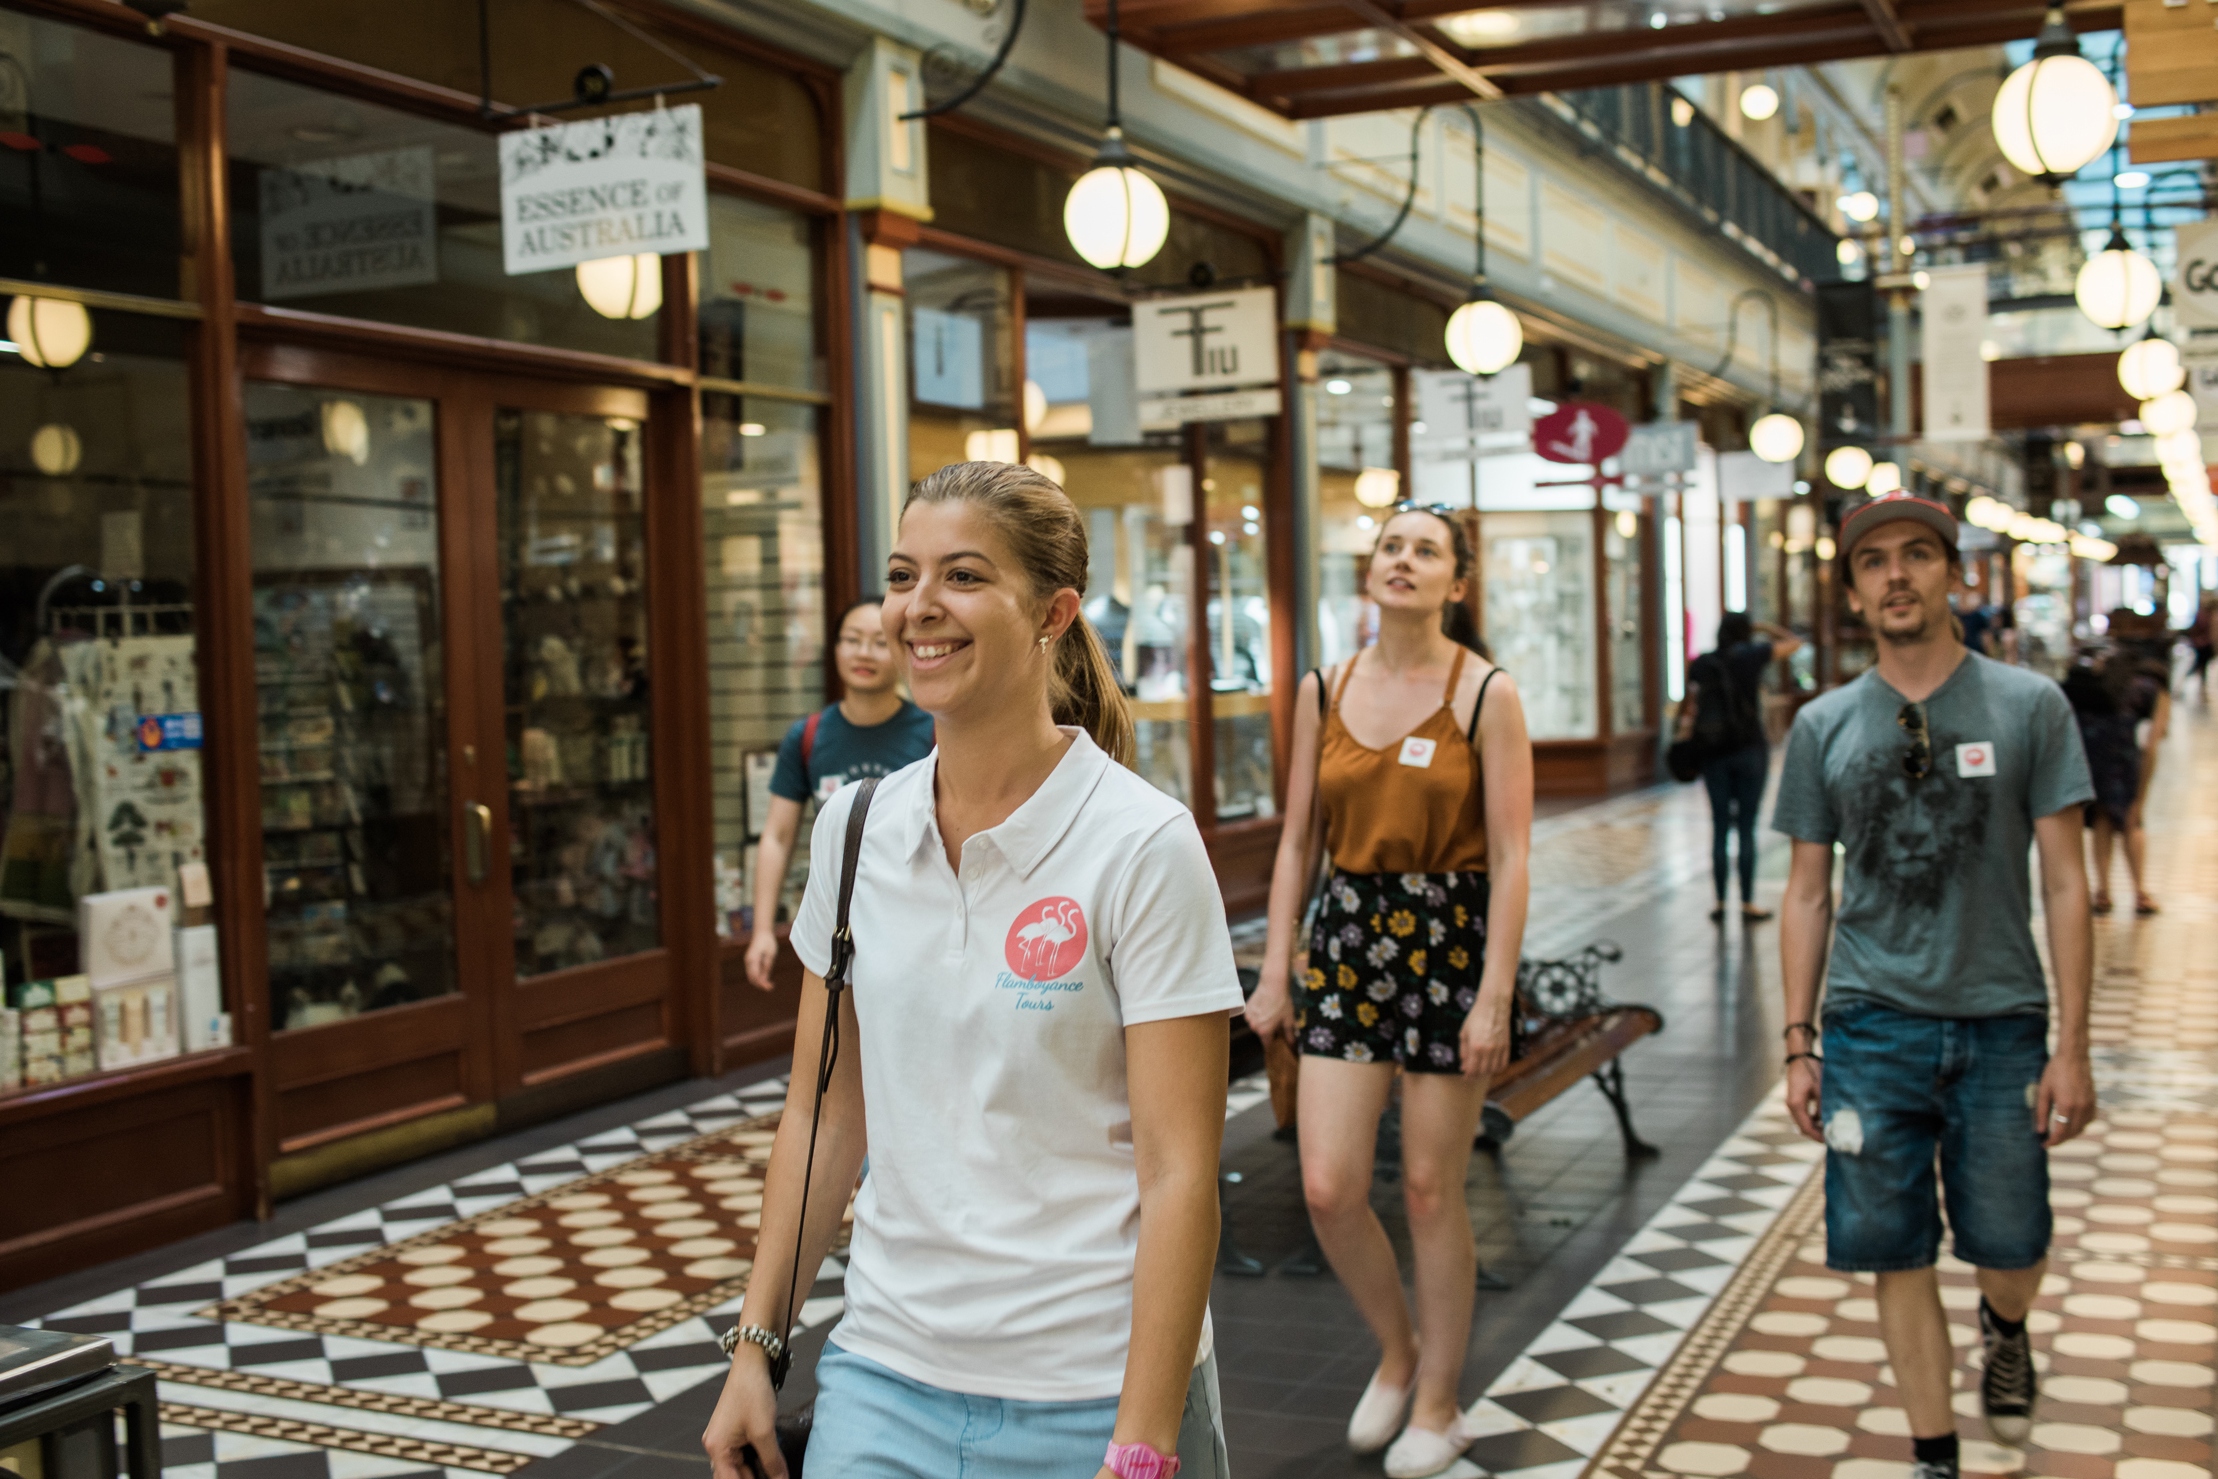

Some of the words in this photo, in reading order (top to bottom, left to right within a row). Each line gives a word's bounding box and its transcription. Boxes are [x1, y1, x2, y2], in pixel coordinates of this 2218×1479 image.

[517, 179, 648, 223] ESSENCE
[656, 181, 686, 203] OF
[519, 209, 688, 257] AUSTRALIA
[995, 972, 1084, 995] Flamboyance
[1015, 992, 1055, 1011] Tours
